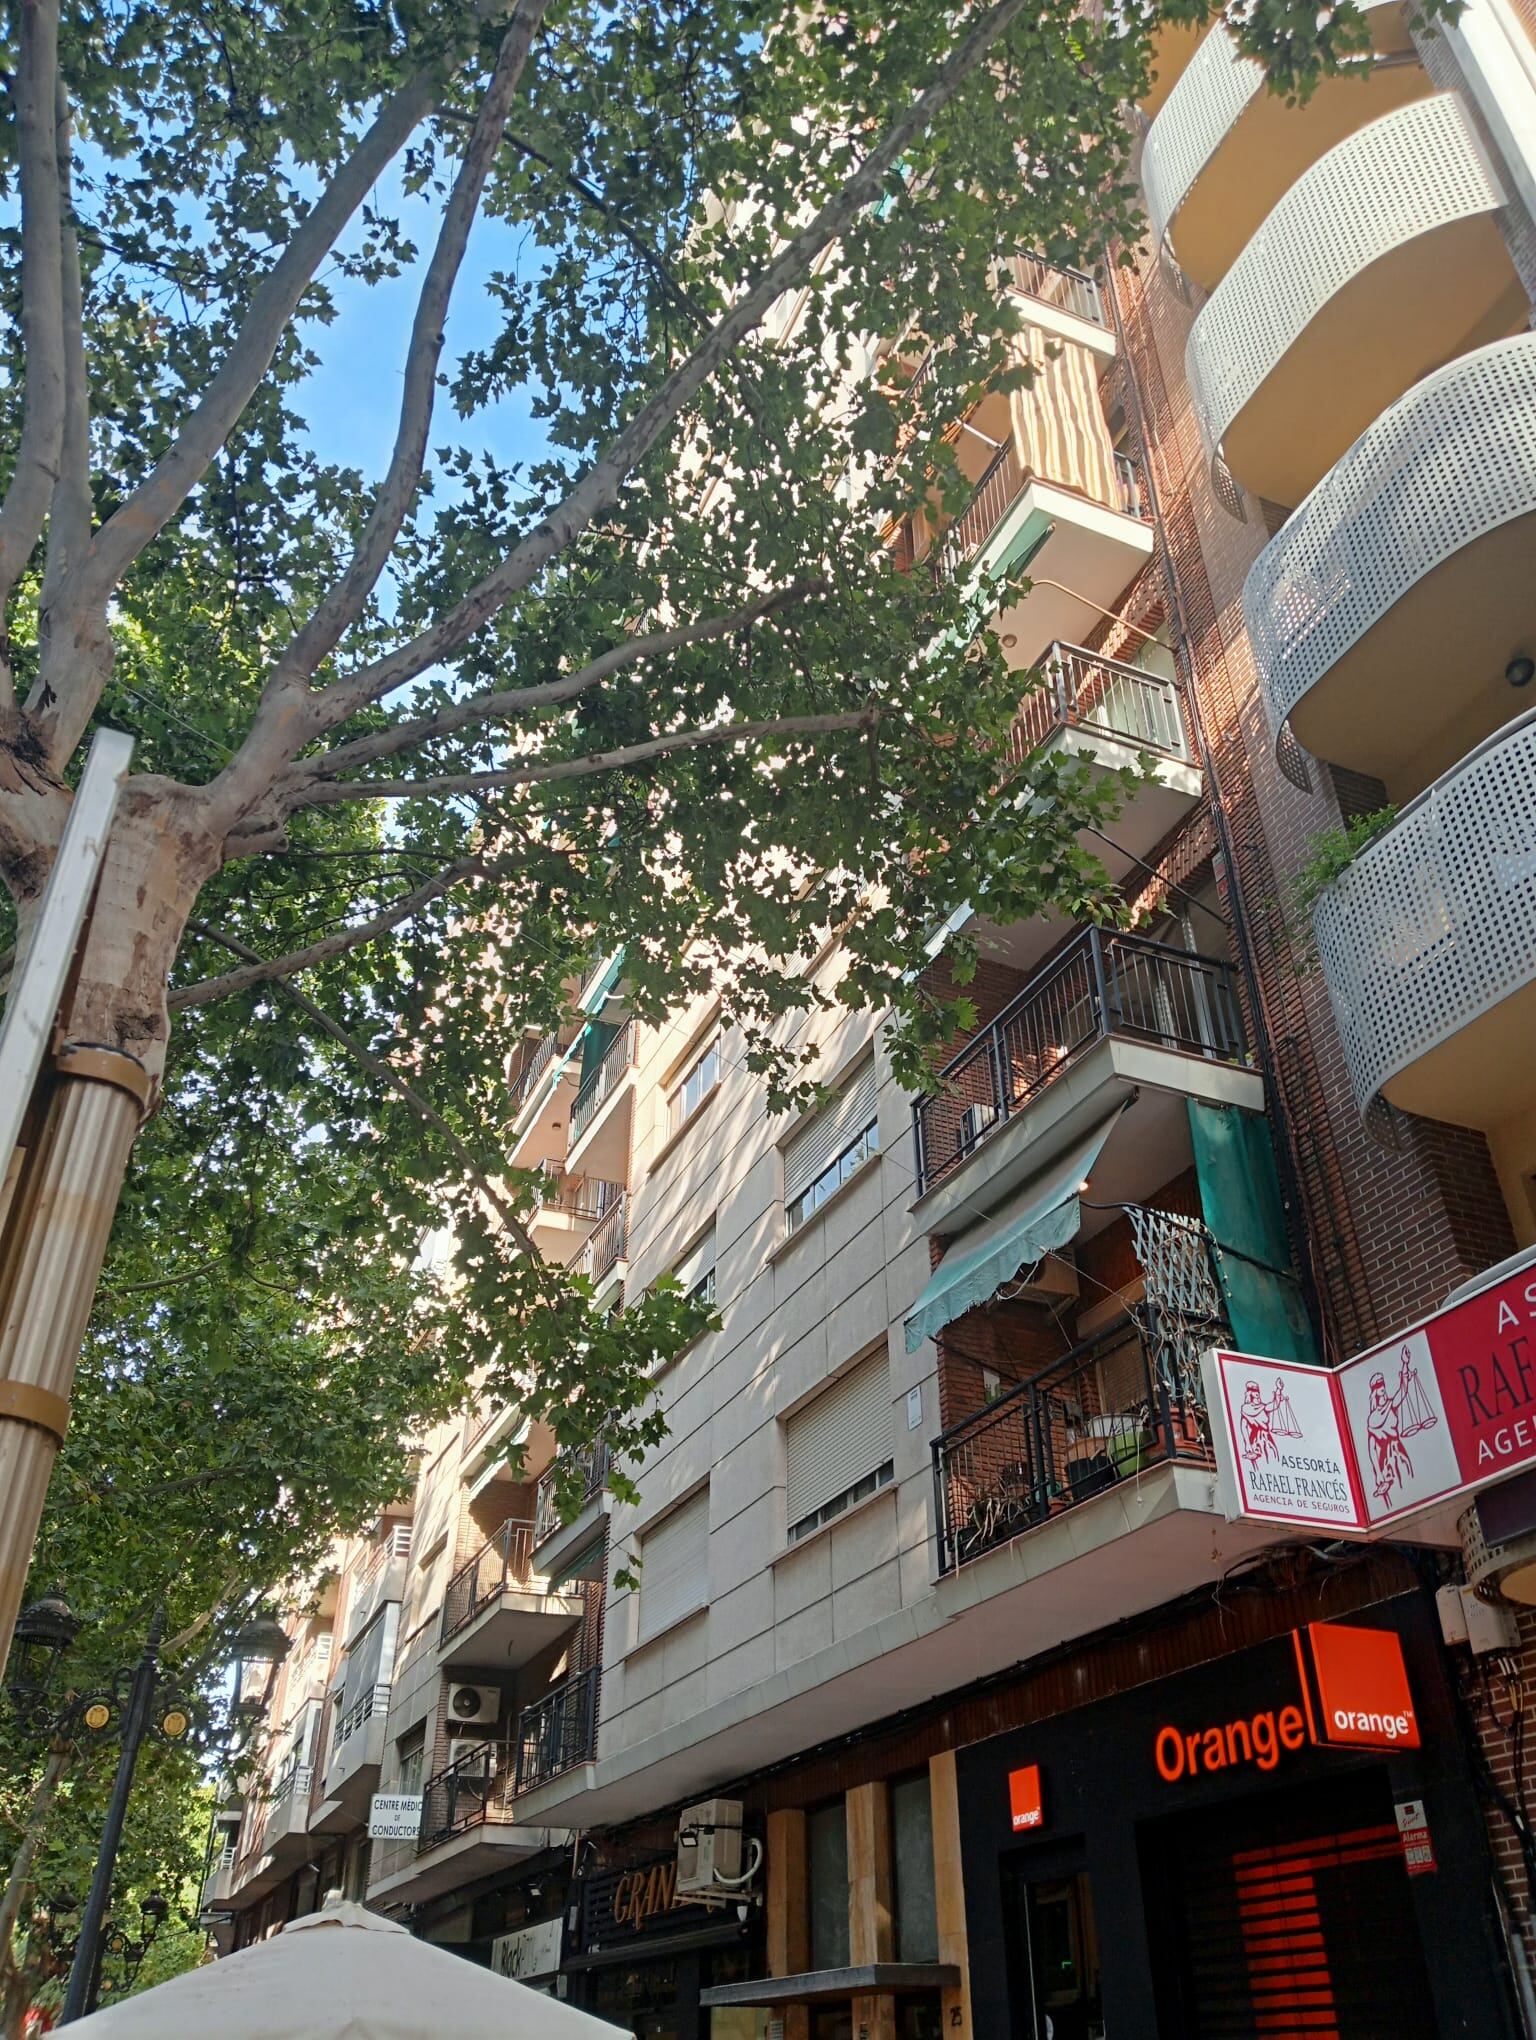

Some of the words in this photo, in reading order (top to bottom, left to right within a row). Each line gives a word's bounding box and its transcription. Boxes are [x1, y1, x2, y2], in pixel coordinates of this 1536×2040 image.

[1478, 1417, 1536, 1466] AGE
[1281, 1455, 1341, 1475] ASESORÍA
[1249, 1471, 1295, 1495] RAFAEL
[1295, 1477, 1348, 1502] FRANCÉS
[1253, 1494, 1294, 1506] AGENCIA
[1297, 1499, 1309, 1509] DE
[1312, 1501, 1350, 1514] SEGUROS
[1155, 1705, 1305, 1782] Orange
[374, 1799, 400, 1811] CENTRE
[950, 2006, 963, 2027] 25
